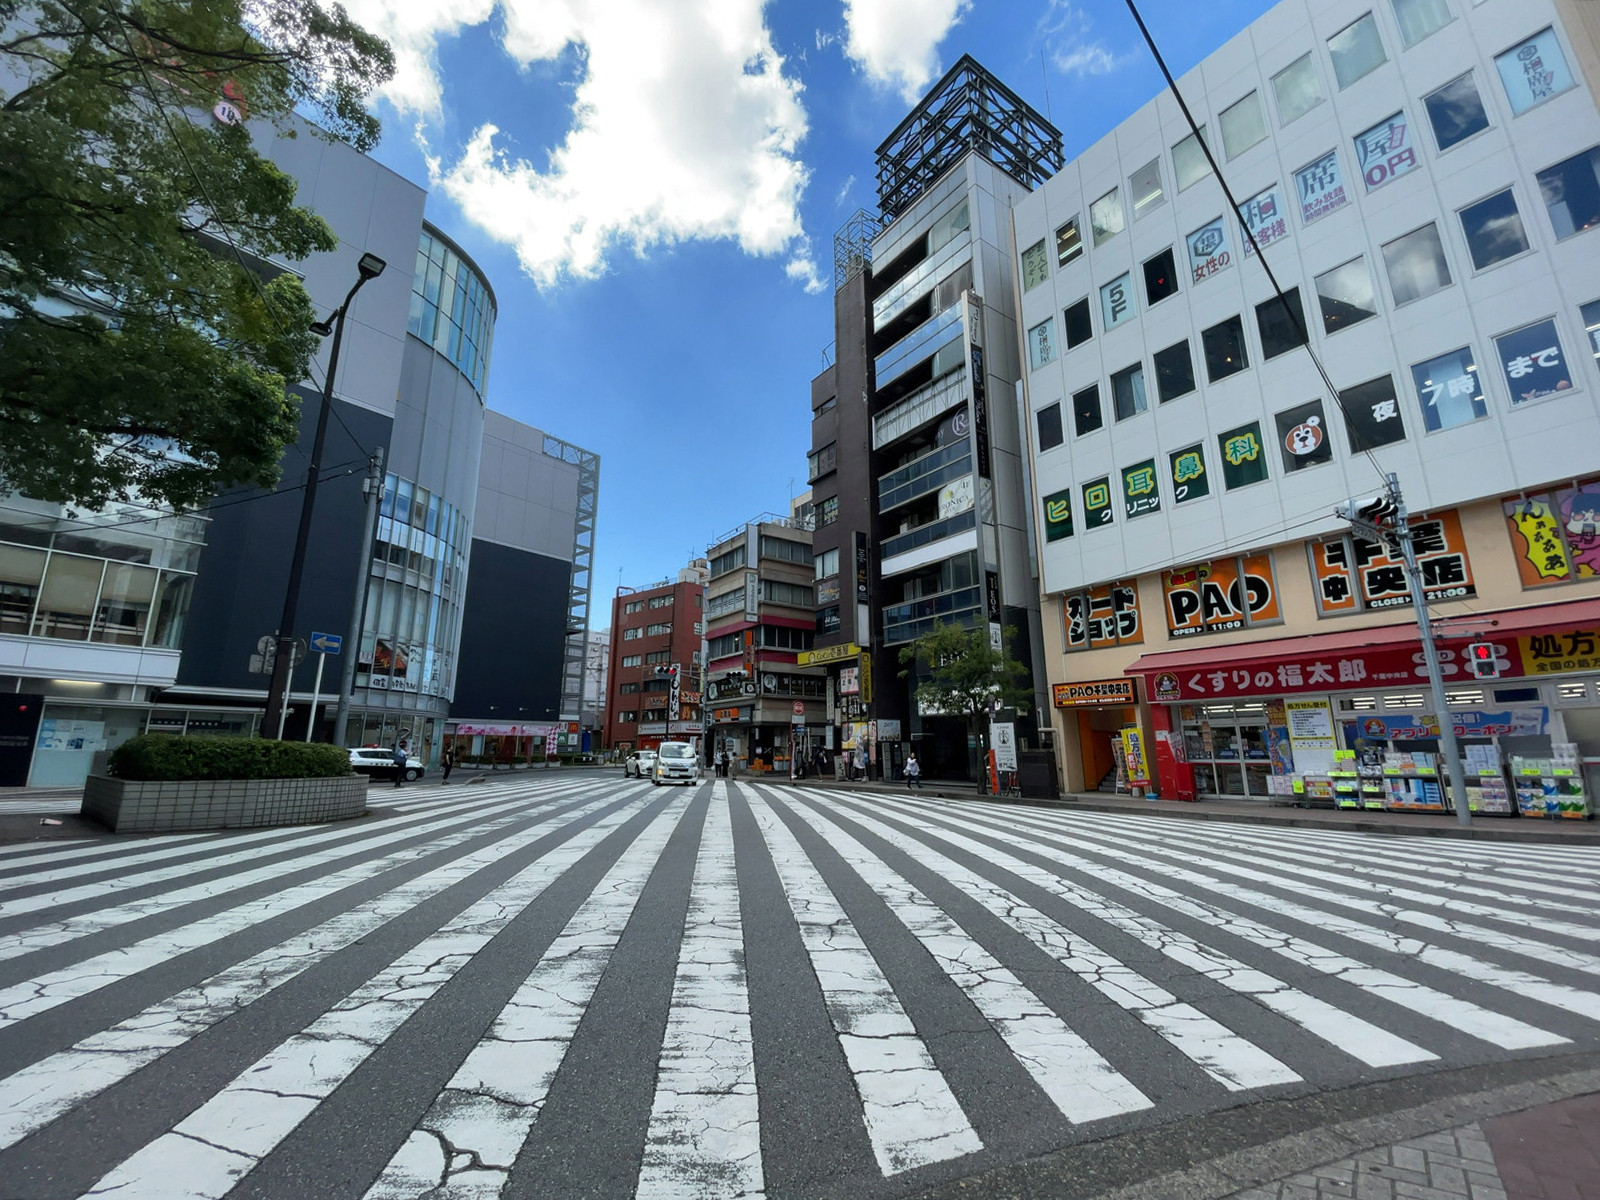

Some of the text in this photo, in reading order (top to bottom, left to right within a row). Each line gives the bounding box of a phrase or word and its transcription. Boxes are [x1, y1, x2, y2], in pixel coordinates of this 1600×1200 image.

[1366, 147, 1416, 186] 0円
[1303, 185, 1345, 213] 飲み放題
[1194, 251, 1230, 283] 女性の
[1109, 283, 1127, 323] 5F
[1370, 346, 1560, 423] 夜 7時 まで
[1321, 553, 1468, 603] 中央店
[1066, 587, 1136, 620] カード
[1168, 573, 1272, 628] PAO
[1370, 586, 1467, 609] CLOSE 21:00
[1069, 611, 1138, 645] ショップ
[1173, 620, 1241, 636] OPEN 11:00
[1418, 652, 1449, 662] くり
[1529, 630, 1600, 660] 処方
[1187, 658, 1367, 693] くすりの福太郎
